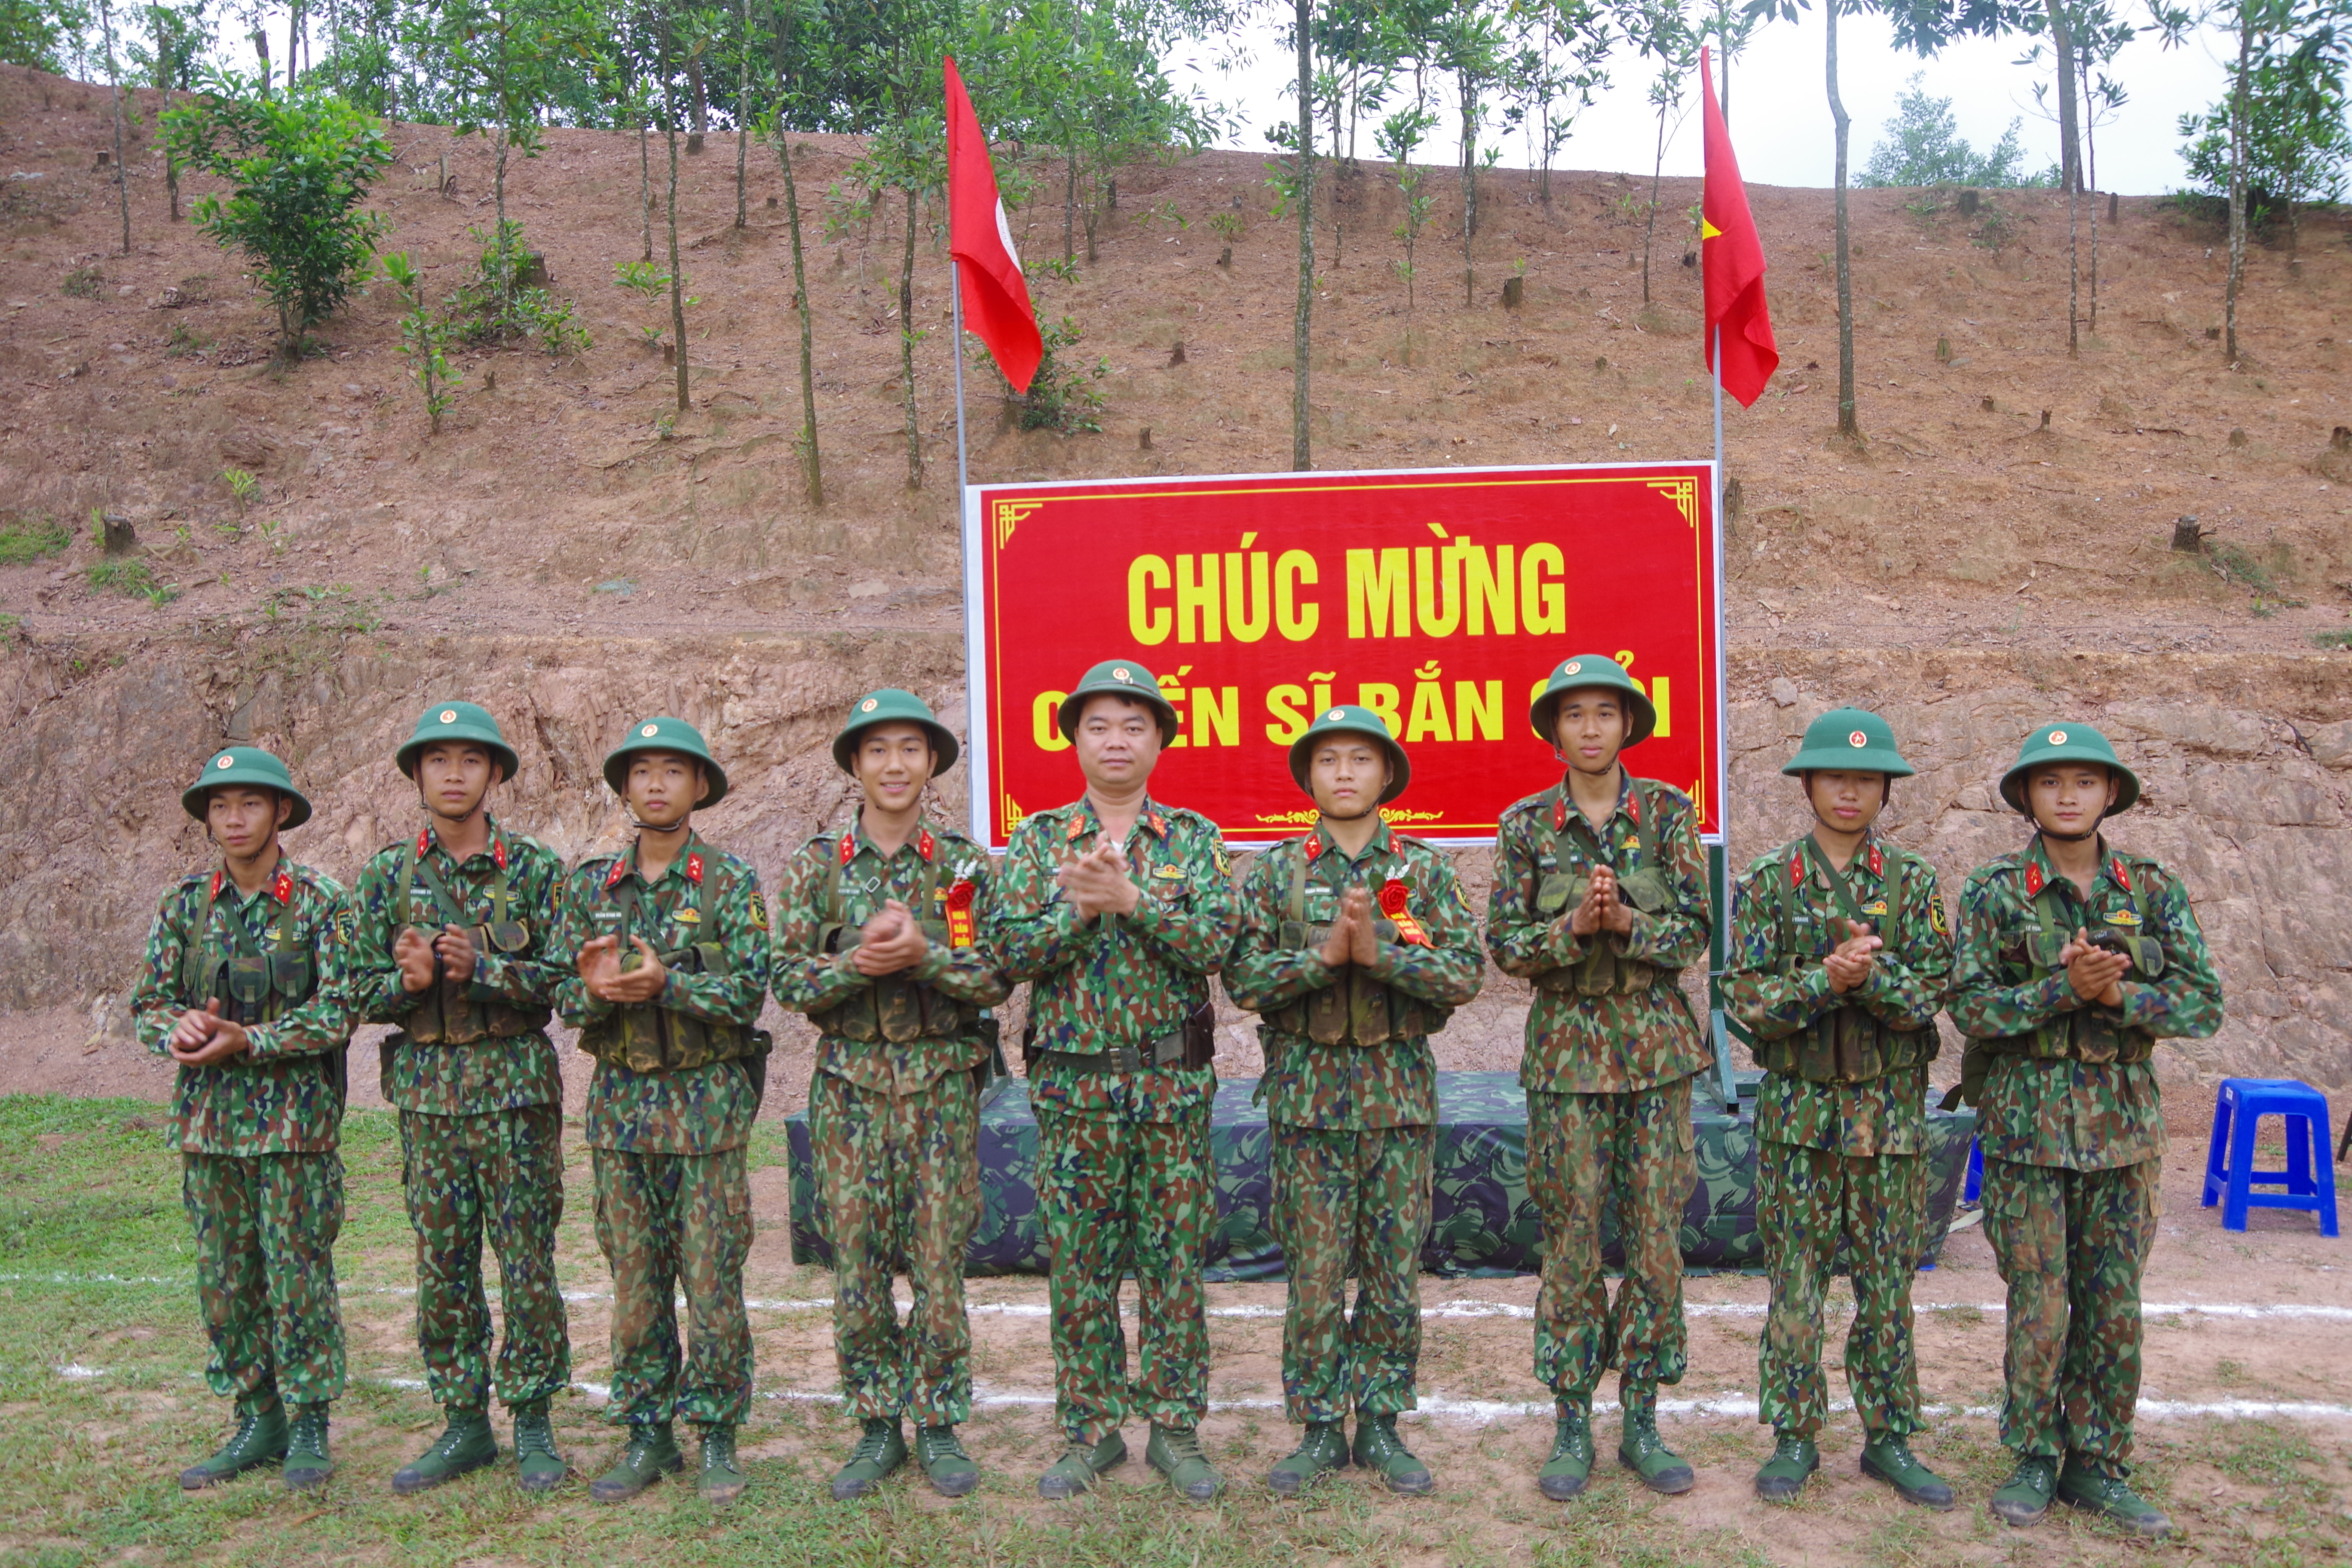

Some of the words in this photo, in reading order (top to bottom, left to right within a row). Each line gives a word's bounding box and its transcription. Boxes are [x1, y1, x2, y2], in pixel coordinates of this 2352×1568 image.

[1127, 531, 1320, 646] CHÚC
[1345, 522, 1566, 639] MỪNG
[1032, 665, 1240, 752] CẾN
[1265, 671, 1337, 746] SĨ
[1358, 660, 1504, 743] BẮN
